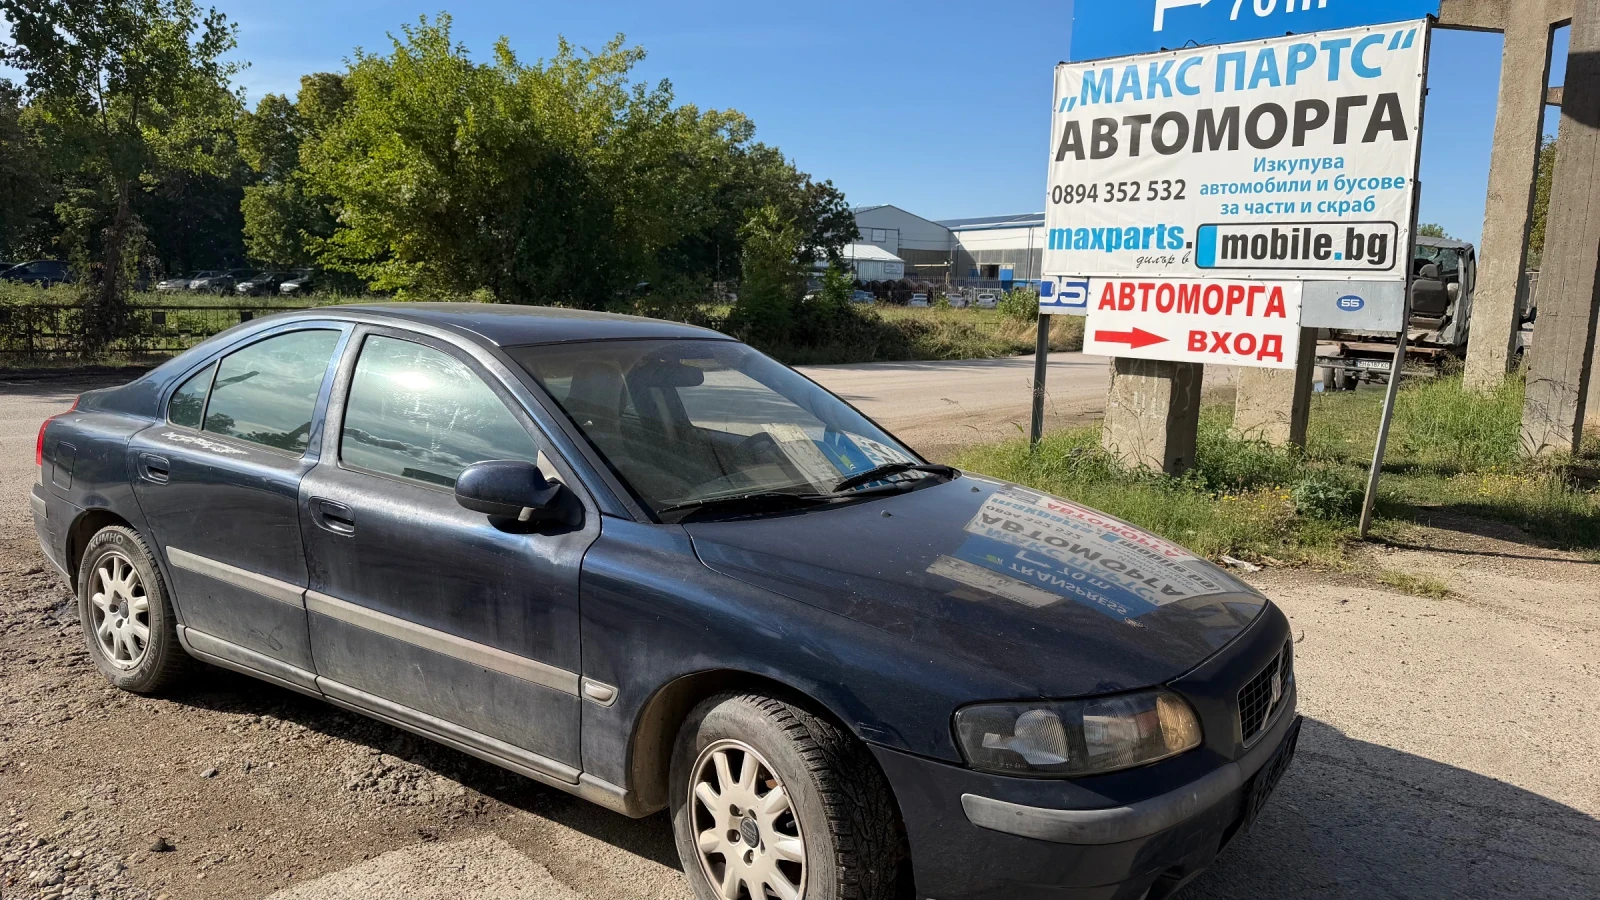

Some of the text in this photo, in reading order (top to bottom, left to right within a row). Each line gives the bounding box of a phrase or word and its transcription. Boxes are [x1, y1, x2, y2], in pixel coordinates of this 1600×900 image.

[1055, 92, 1408, 161] АВТОМОРГА
[1253, 156, 1344, 175] Изкупува
[1052, 179, 1186, 204] 0894 352 532
[1200, 174, 1405, 195] автомобили и бусове
[1220, 195, 1376, 216] за части и скраб
[1221, 227, 1388, 265] mobile.bg
[1136, 251, 1191, 268] дилър в
[1098, 282, 1286, 318] АВТОМОРГА
[1341, 299, 1360, 307] 55
[1187, 330, 1283, 362] ВХОД
[91, 533, 123, 550] KUMHO
